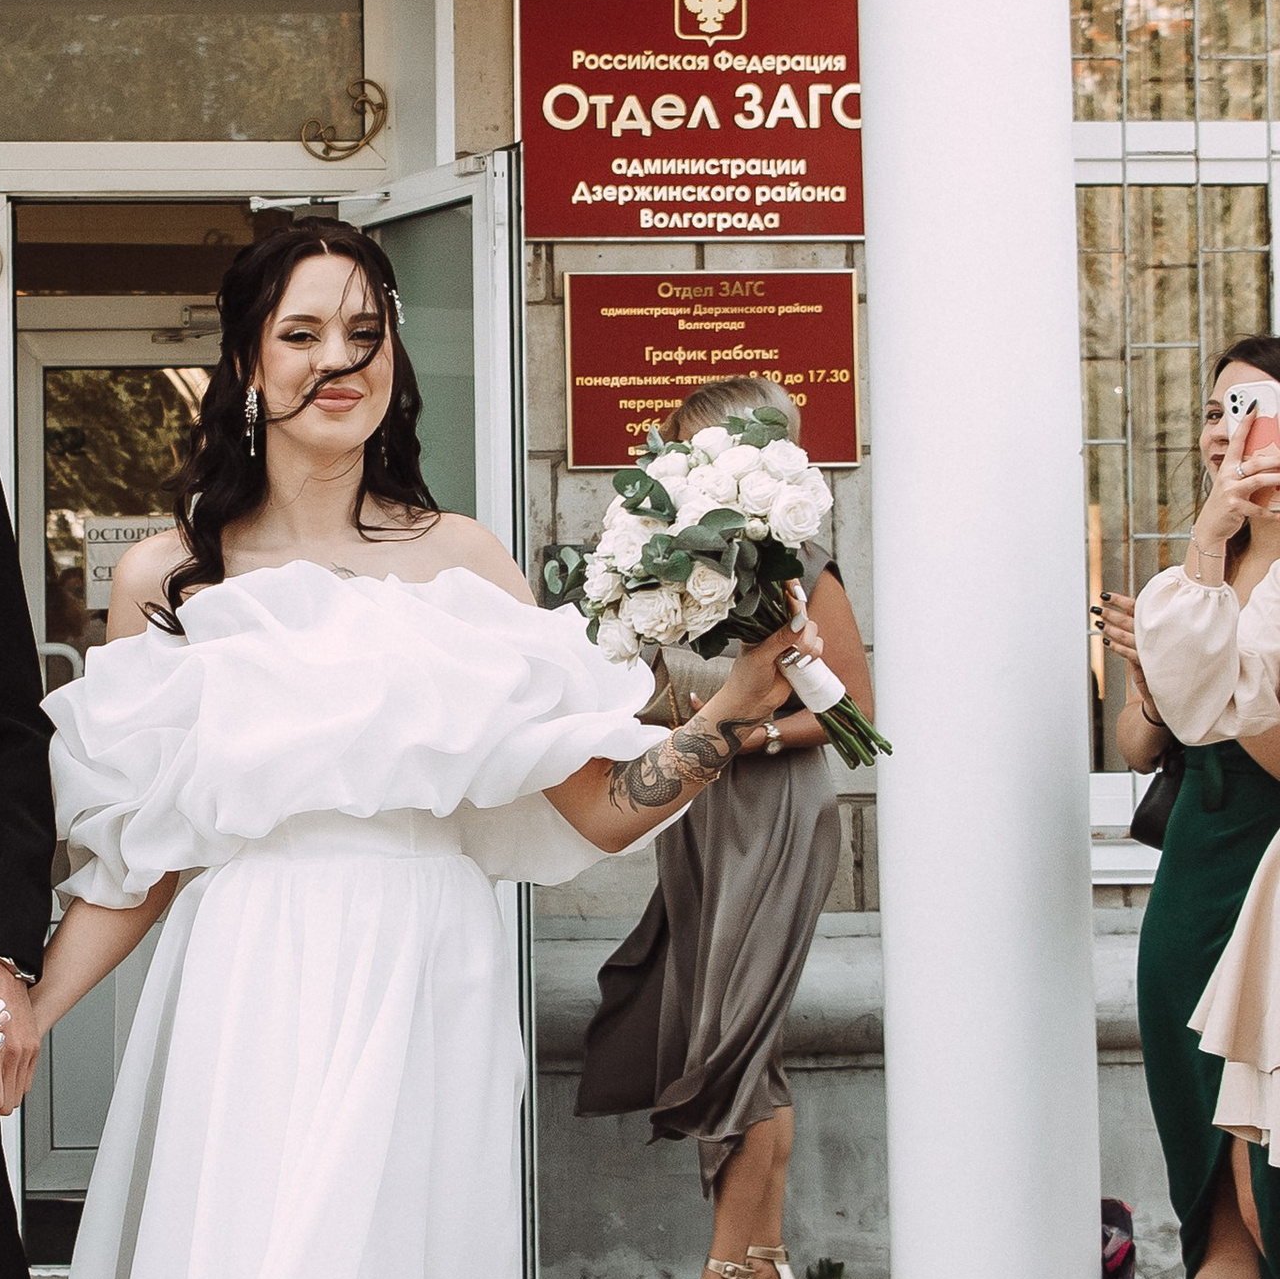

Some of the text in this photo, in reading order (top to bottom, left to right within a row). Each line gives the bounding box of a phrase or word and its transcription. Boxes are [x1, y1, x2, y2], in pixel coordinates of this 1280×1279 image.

[572, 50, 847, 74] Российская Федерация
[542, 82, 862, 137] Отдел ЗАГС
[611, 158, 807, 179] администрации
[571, 181, 847, 205] Дзержинского района
[639, 208, 780, 232] Волгограда
[657, 281, 766, 300] Отдел ЗАГС
[600, 303, 823, 318] администрации Дзержинского района
[678, 319, 746, 332] Волгограда
[644, 344, 780, 365] График работы:
[784, 373, 804, 386] до
[808, 369, 851, 383] 17.30
[619, 399, 683, 413] перерыв
[87, 527, 172, 541] ОСТОРО
